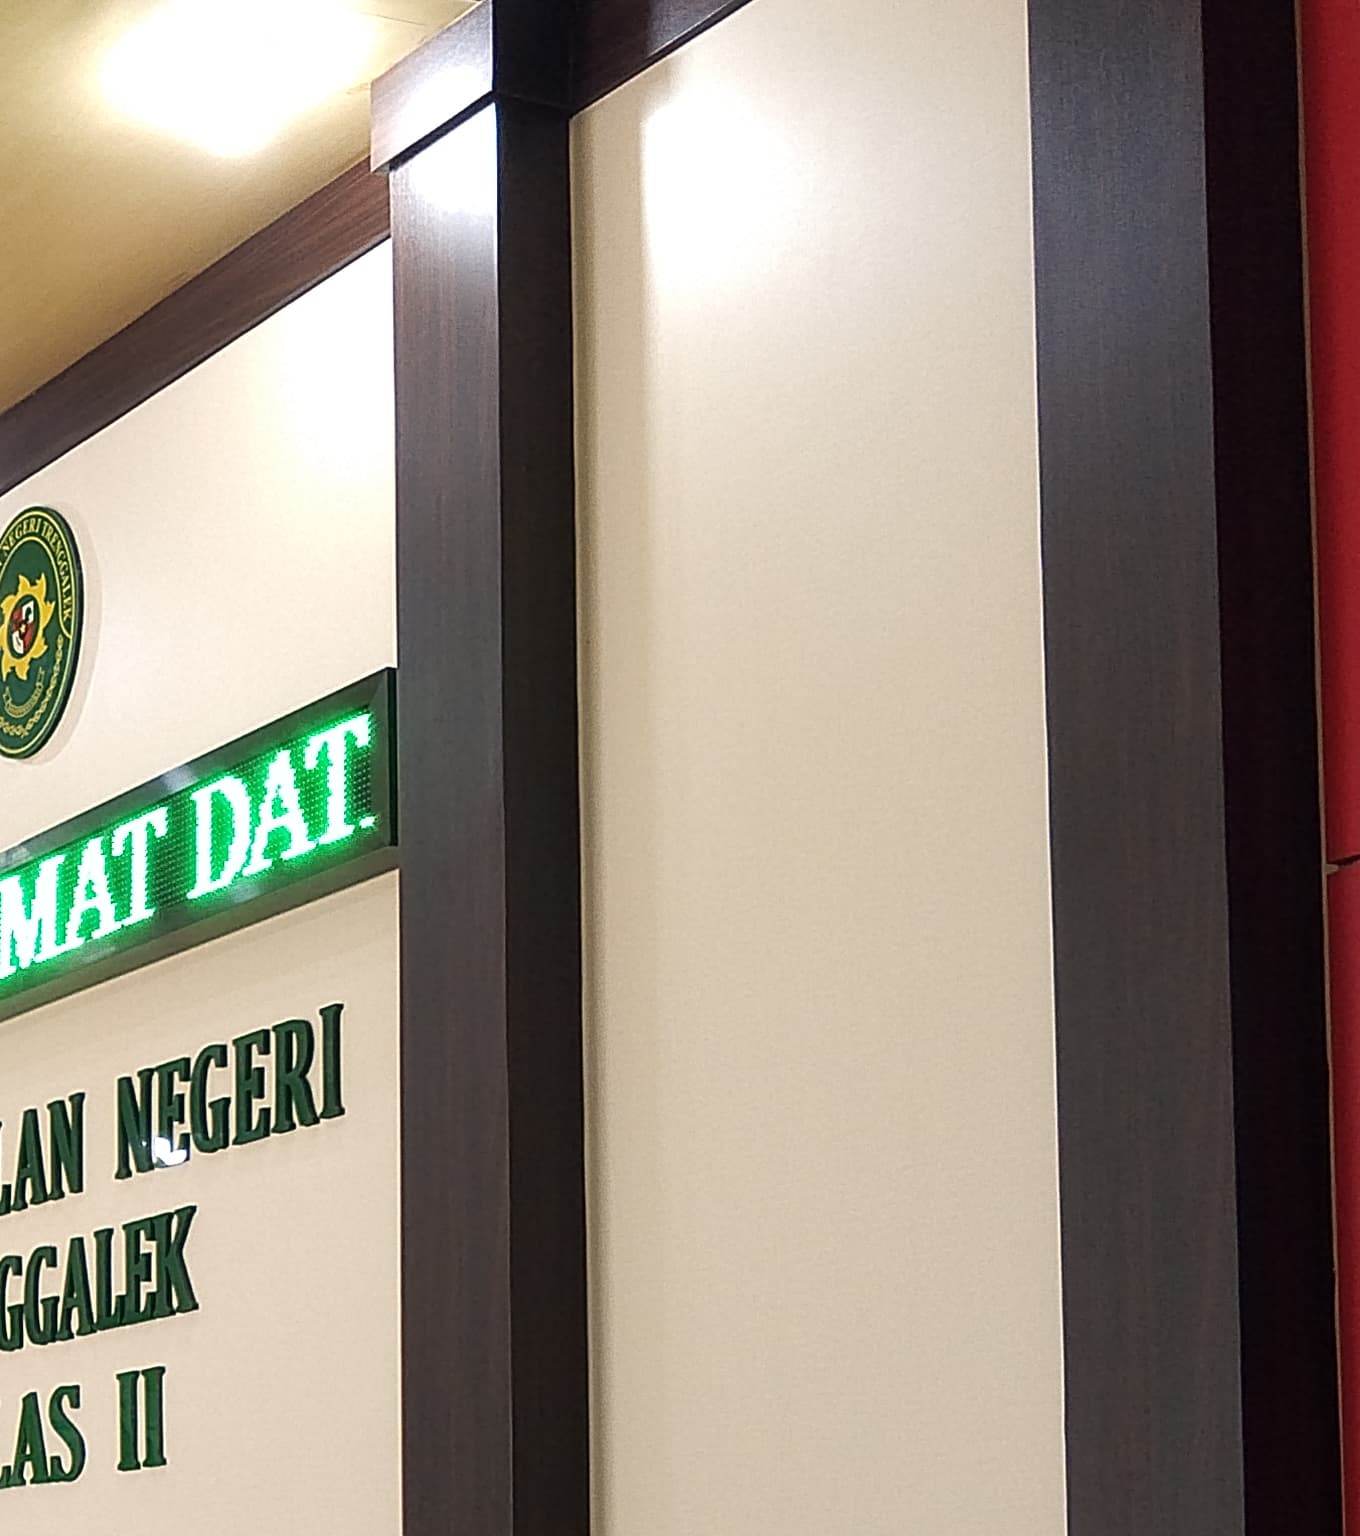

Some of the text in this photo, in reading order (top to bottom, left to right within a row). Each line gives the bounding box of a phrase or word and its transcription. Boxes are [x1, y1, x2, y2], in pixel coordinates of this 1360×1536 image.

[2, 518, 41, 556] NEGERI
[41, 521, 71, 622] TRENGGALEK
[187, 712, 377, 899] DAT
[115, 1003, 346, 1180] NEGERI
[116, 1367, 166, 1471] II
